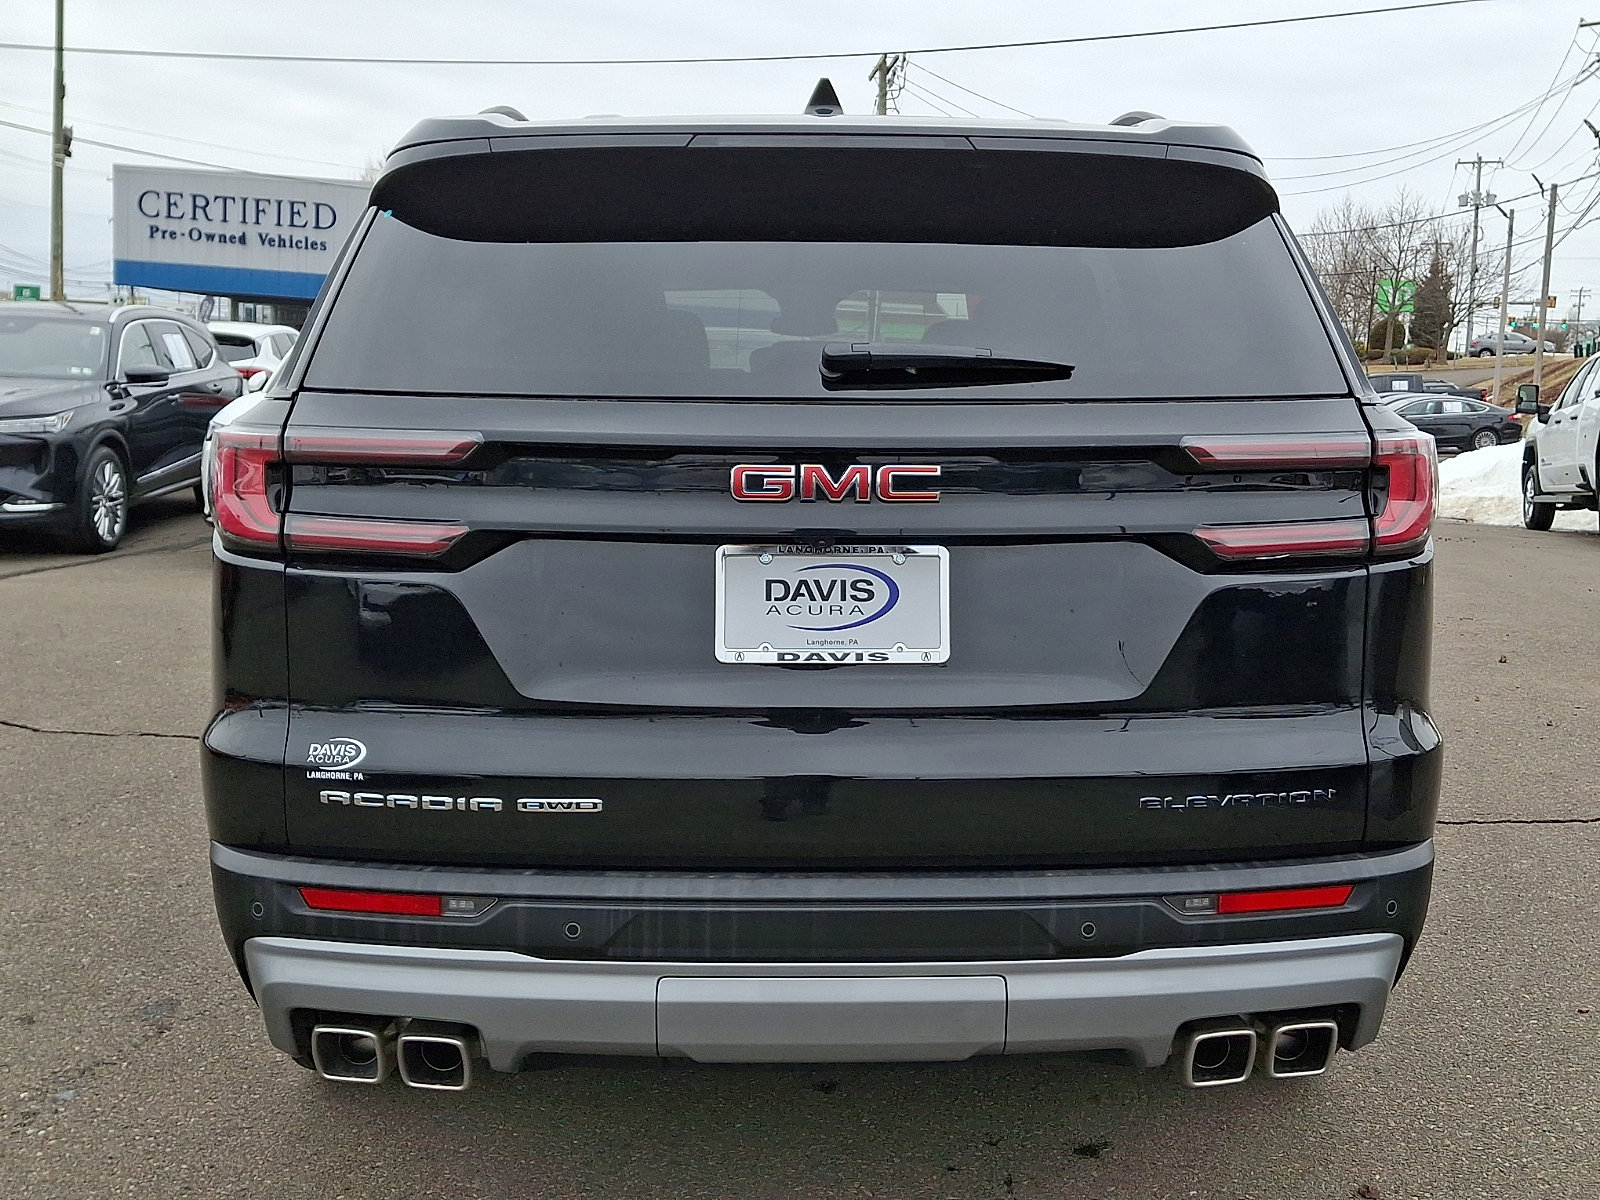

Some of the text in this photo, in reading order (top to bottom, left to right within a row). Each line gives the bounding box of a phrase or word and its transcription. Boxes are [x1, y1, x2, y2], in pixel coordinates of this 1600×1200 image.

[137, 190, 338, 230] CERTIFIED
[148, 224, 328, 251] Pre-Owned Vehicles
[730, 464, 942, 503] GMC
[765, 578, 875, 602] DAVIS
[766, 604, 865, 616] ACURA
[806, 638, 859, 647] Langhorne, PA
[777, 651, 890, 662] DAVIS
[309, 743, 356, 756] DAVIS
[307, 755, 350, 763] ACURA
[306, 771, 364, 780] LANGHORNE, PA
[319, 789, 602, 812] ACADIA AWD
[1139, 788, 1337, 811] ELEVATION
